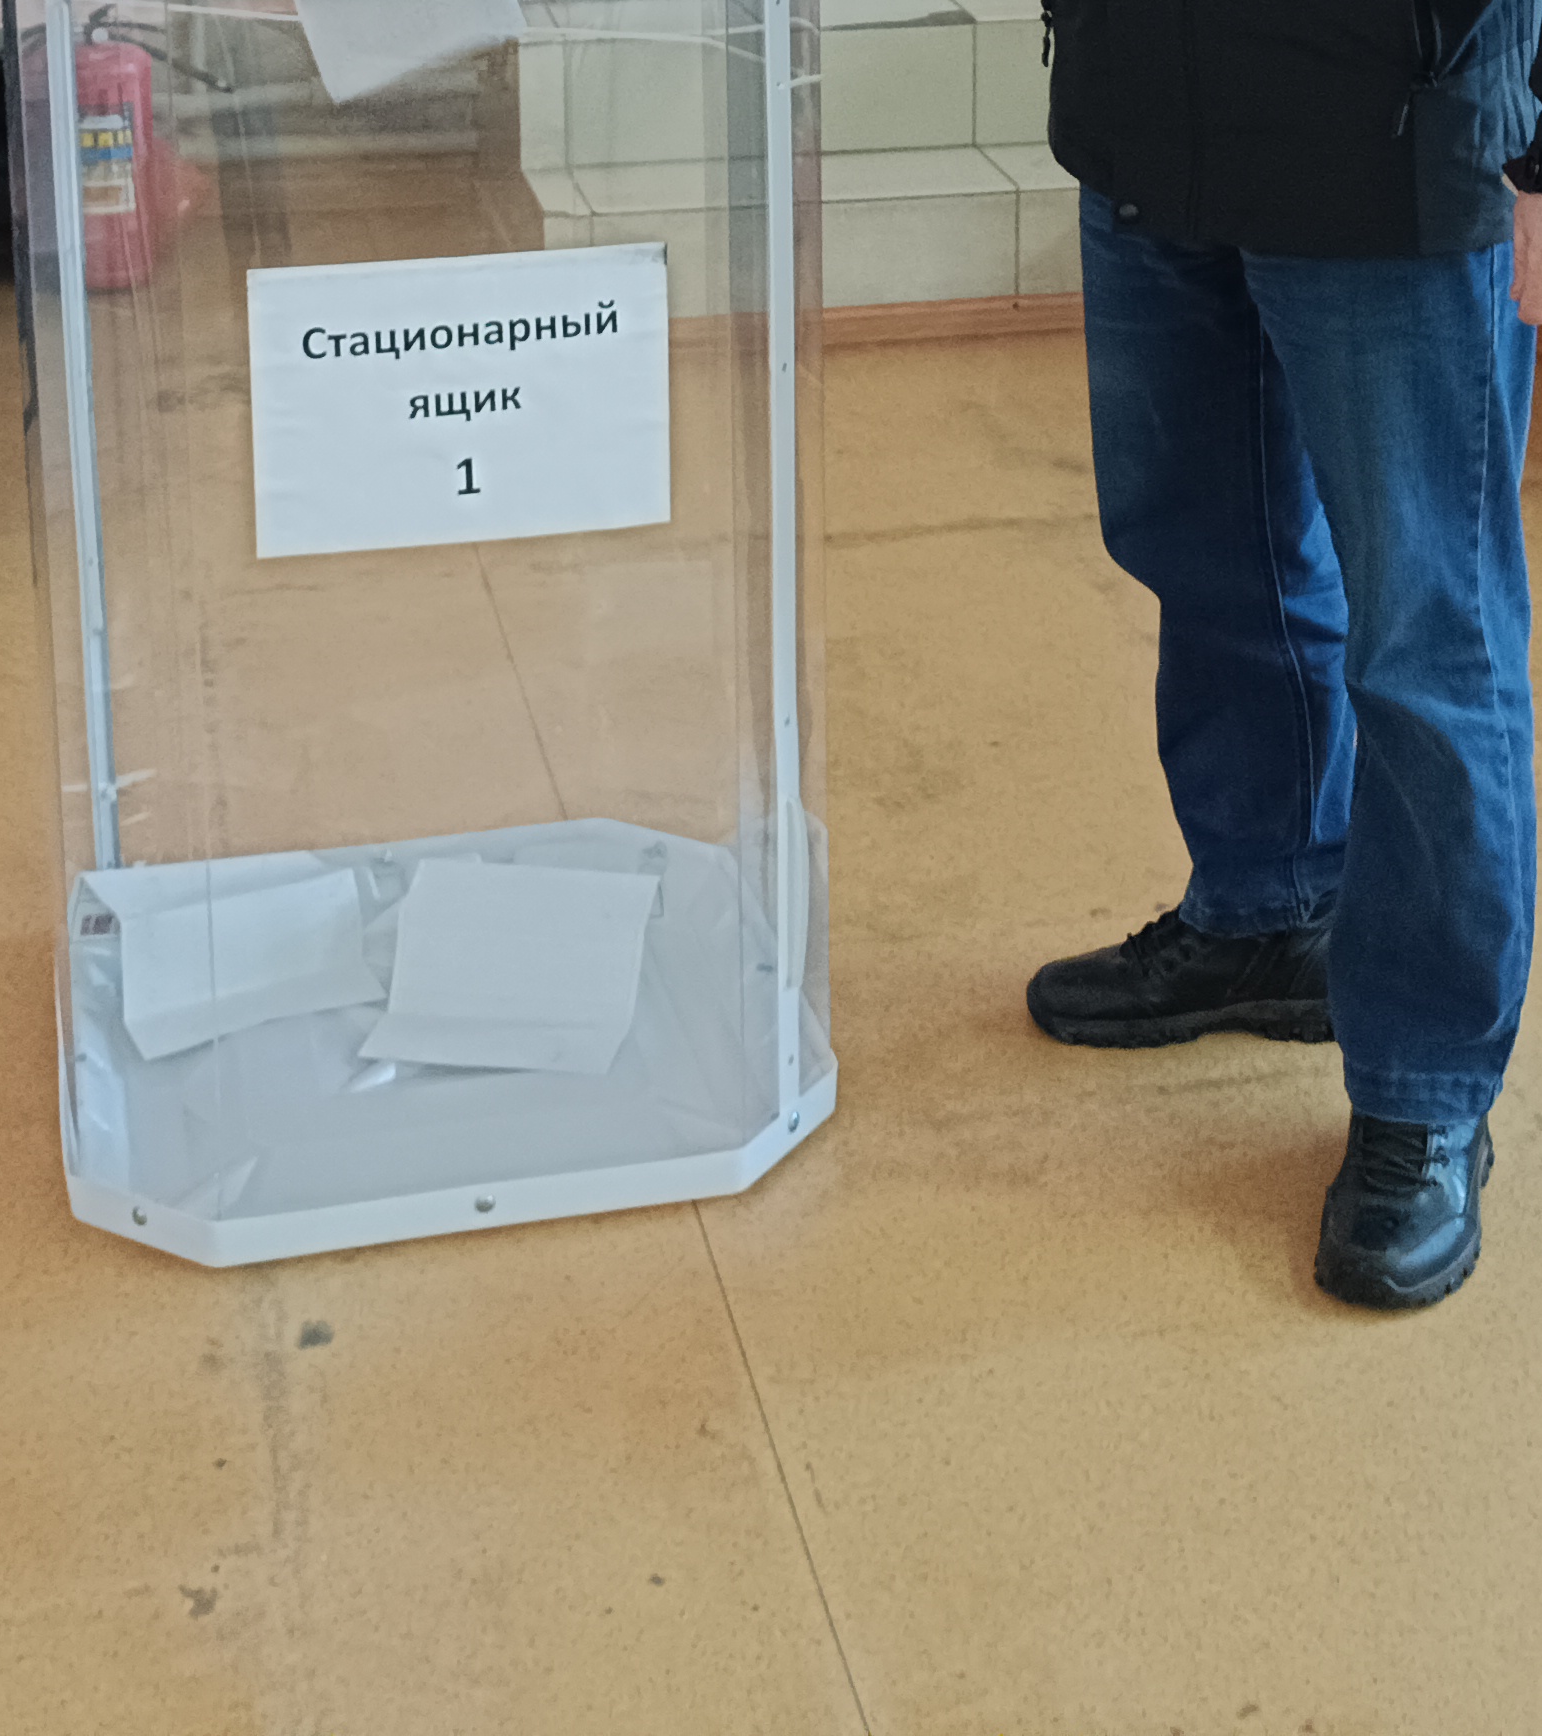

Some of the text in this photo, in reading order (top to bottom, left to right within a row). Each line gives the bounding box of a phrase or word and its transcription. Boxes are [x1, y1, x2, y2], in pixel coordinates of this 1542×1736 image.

[301, 299, 618, 360] Стационарный
[408, 386, 521, 422] ящик
[456, 456, 481, 496] 1
